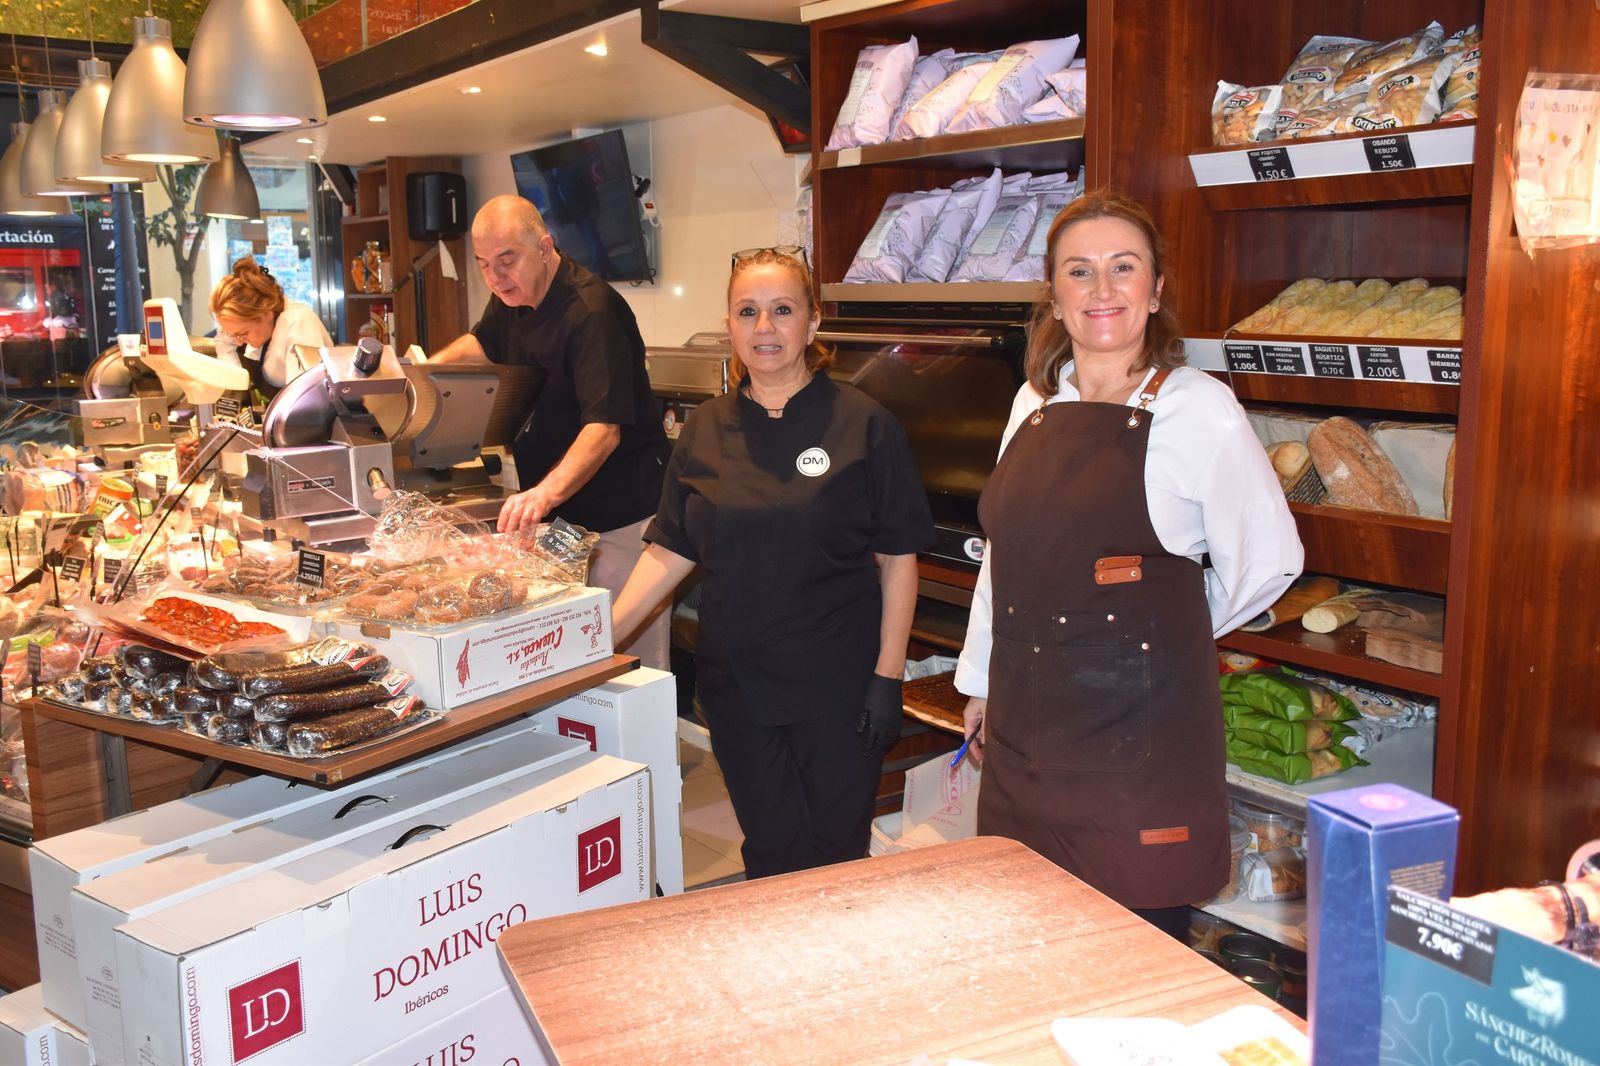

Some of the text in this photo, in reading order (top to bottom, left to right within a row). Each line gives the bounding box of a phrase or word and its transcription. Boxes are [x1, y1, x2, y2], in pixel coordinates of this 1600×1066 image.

[1381, 160, 1404, 168] 1.50€
[1367, 366, 1400, 378] 2.00€
[803, 457, 824, 465] DM
[1356, 686, 1393, 706] OBANDO
[636, 778, 646, 893] www.luisdomingo.com
[418, 873, 483, 927] LUIS
[373, 903, 527, 1002] DOMINGO
[1417, 926, 1464, 960] 7.90€
[241, 987, 291, 1040] LD
[404, 985, 449, 1014] Ibéricos
